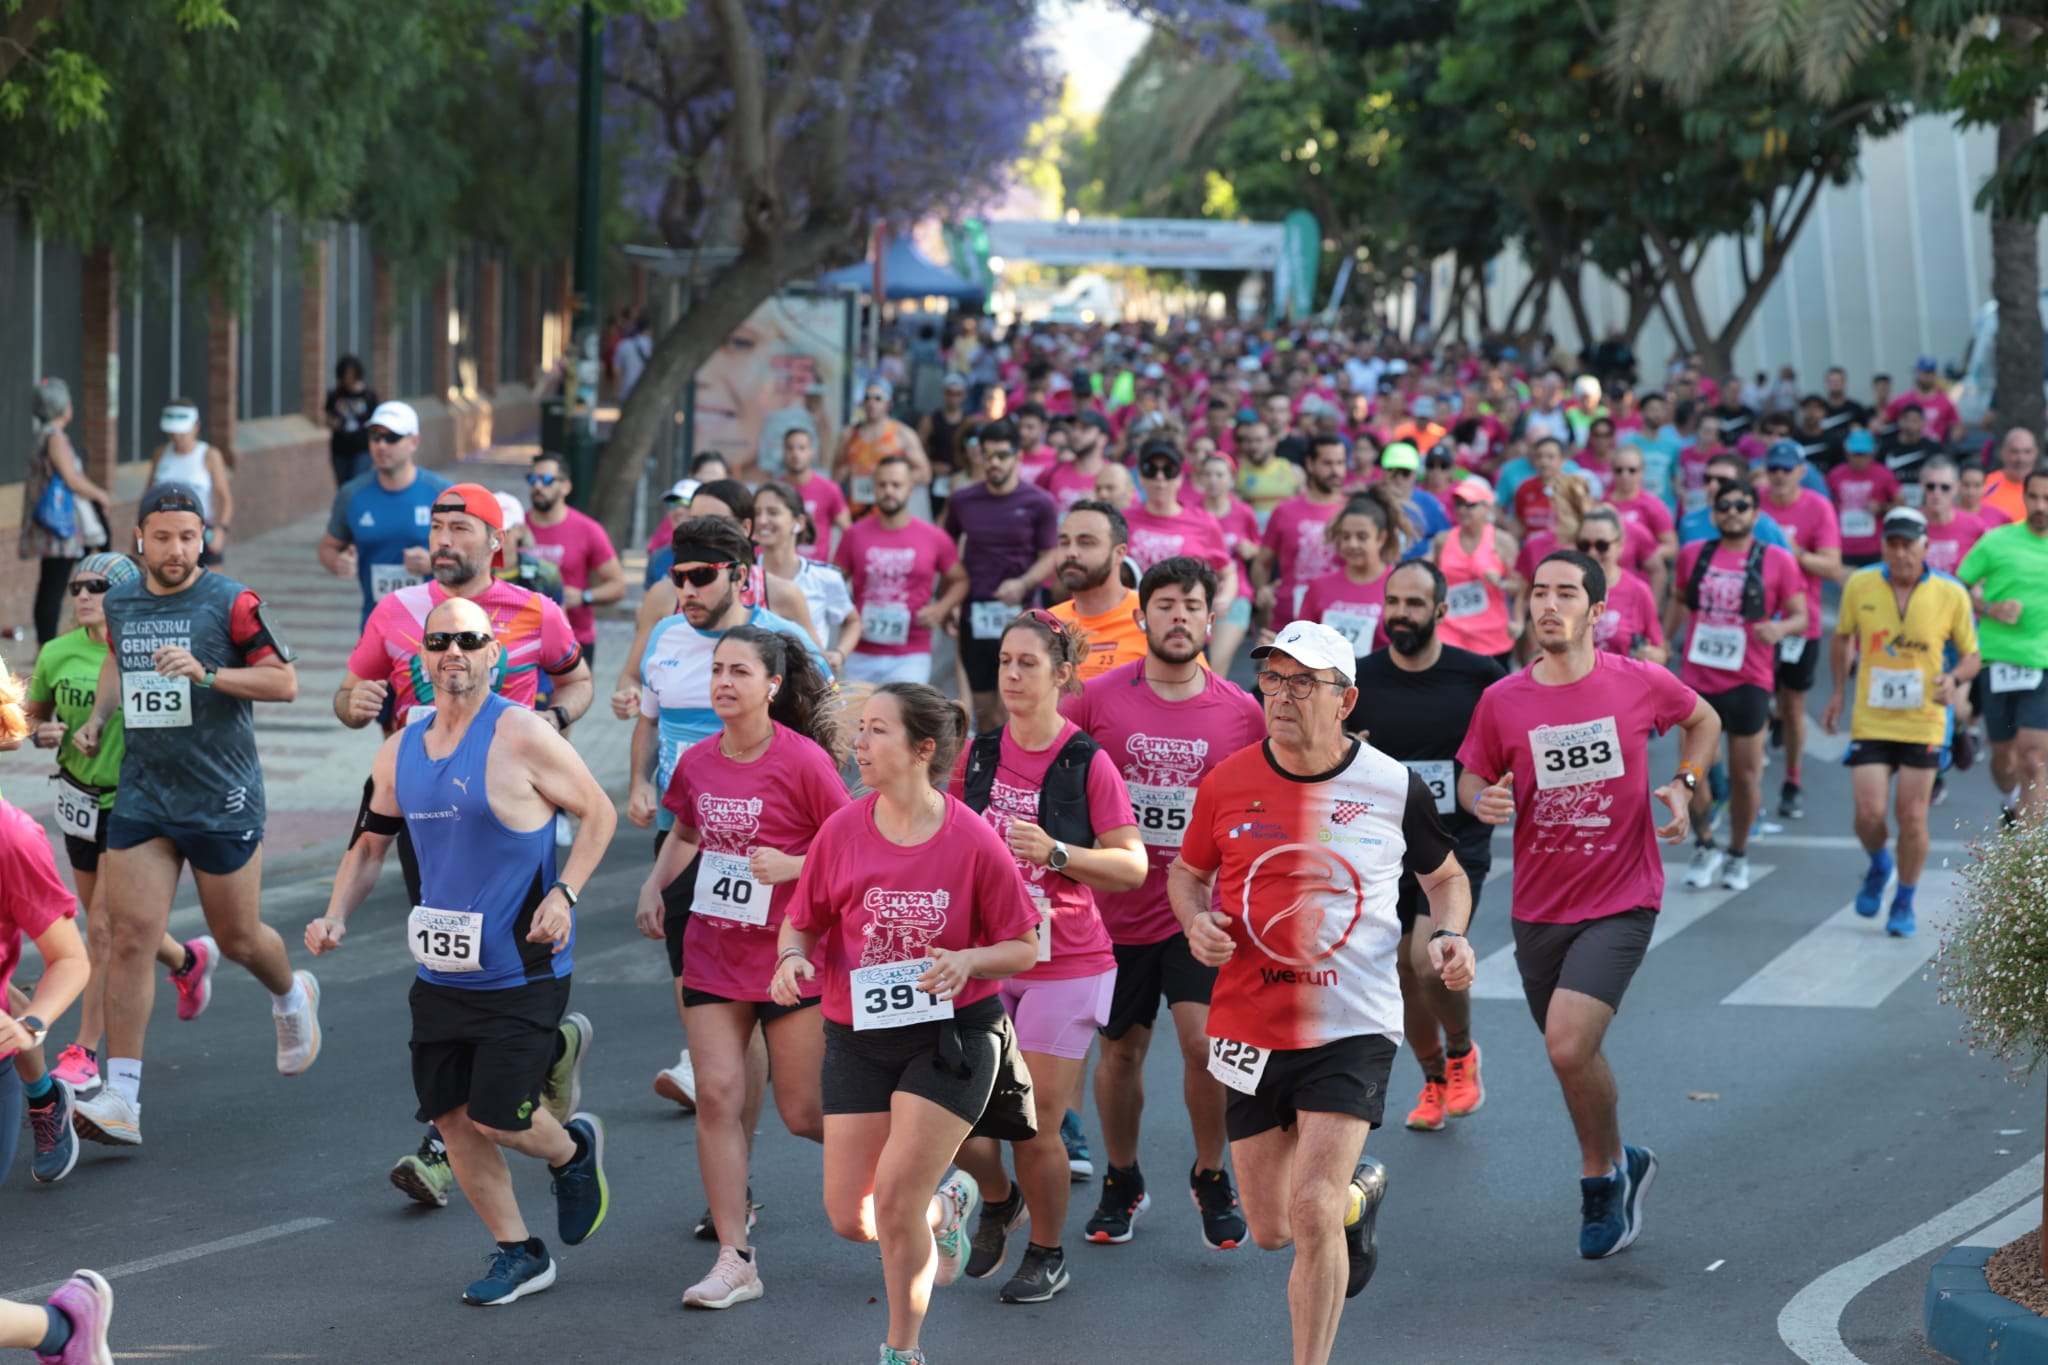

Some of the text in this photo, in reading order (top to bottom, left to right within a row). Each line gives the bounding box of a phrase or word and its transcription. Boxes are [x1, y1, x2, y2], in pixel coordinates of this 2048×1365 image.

[137, 619, 191, 634] GENERALI
[131, 691, 182, 713] 163
[1882, 682, 1908, 700] 91
[1544, 740, 1612, 772] 383
[57, 796, 91, 829] 260
[712, 876, 752, 905] 40
[869, 891, 935, 906] Carrera
[877, 904, 938, 920] Prensa
[416, 929, 471, 960] 135
[1260, 967, 1338, 987] werun
[1213, 1037, 1260, 1076] 322
